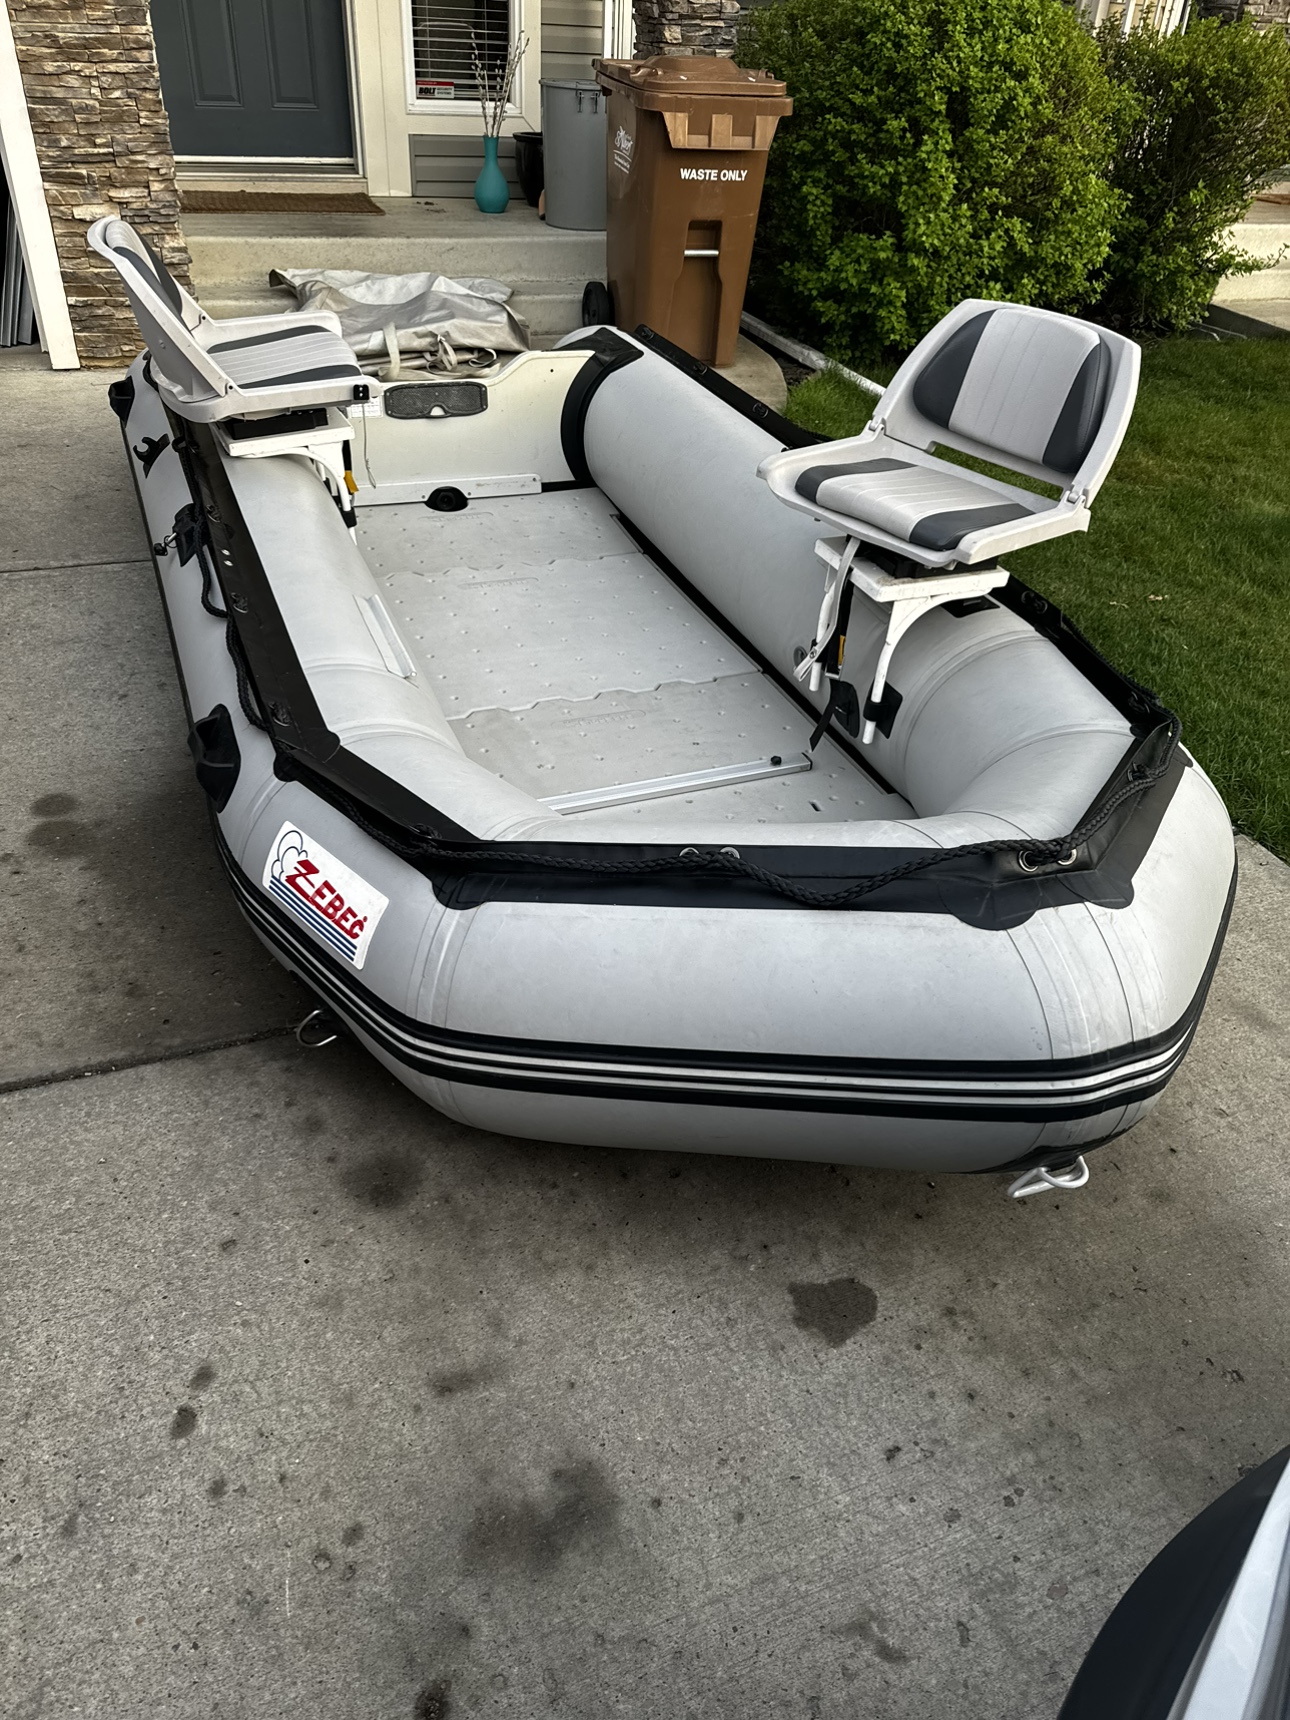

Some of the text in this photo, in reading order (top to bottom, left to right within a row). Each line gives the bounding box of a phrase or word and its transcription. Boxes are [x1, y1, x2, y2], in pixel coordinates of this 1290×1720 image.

[680, 167, 748, 182] WASTE ONLY
[285, 859, 367, 940] ZEBEC
